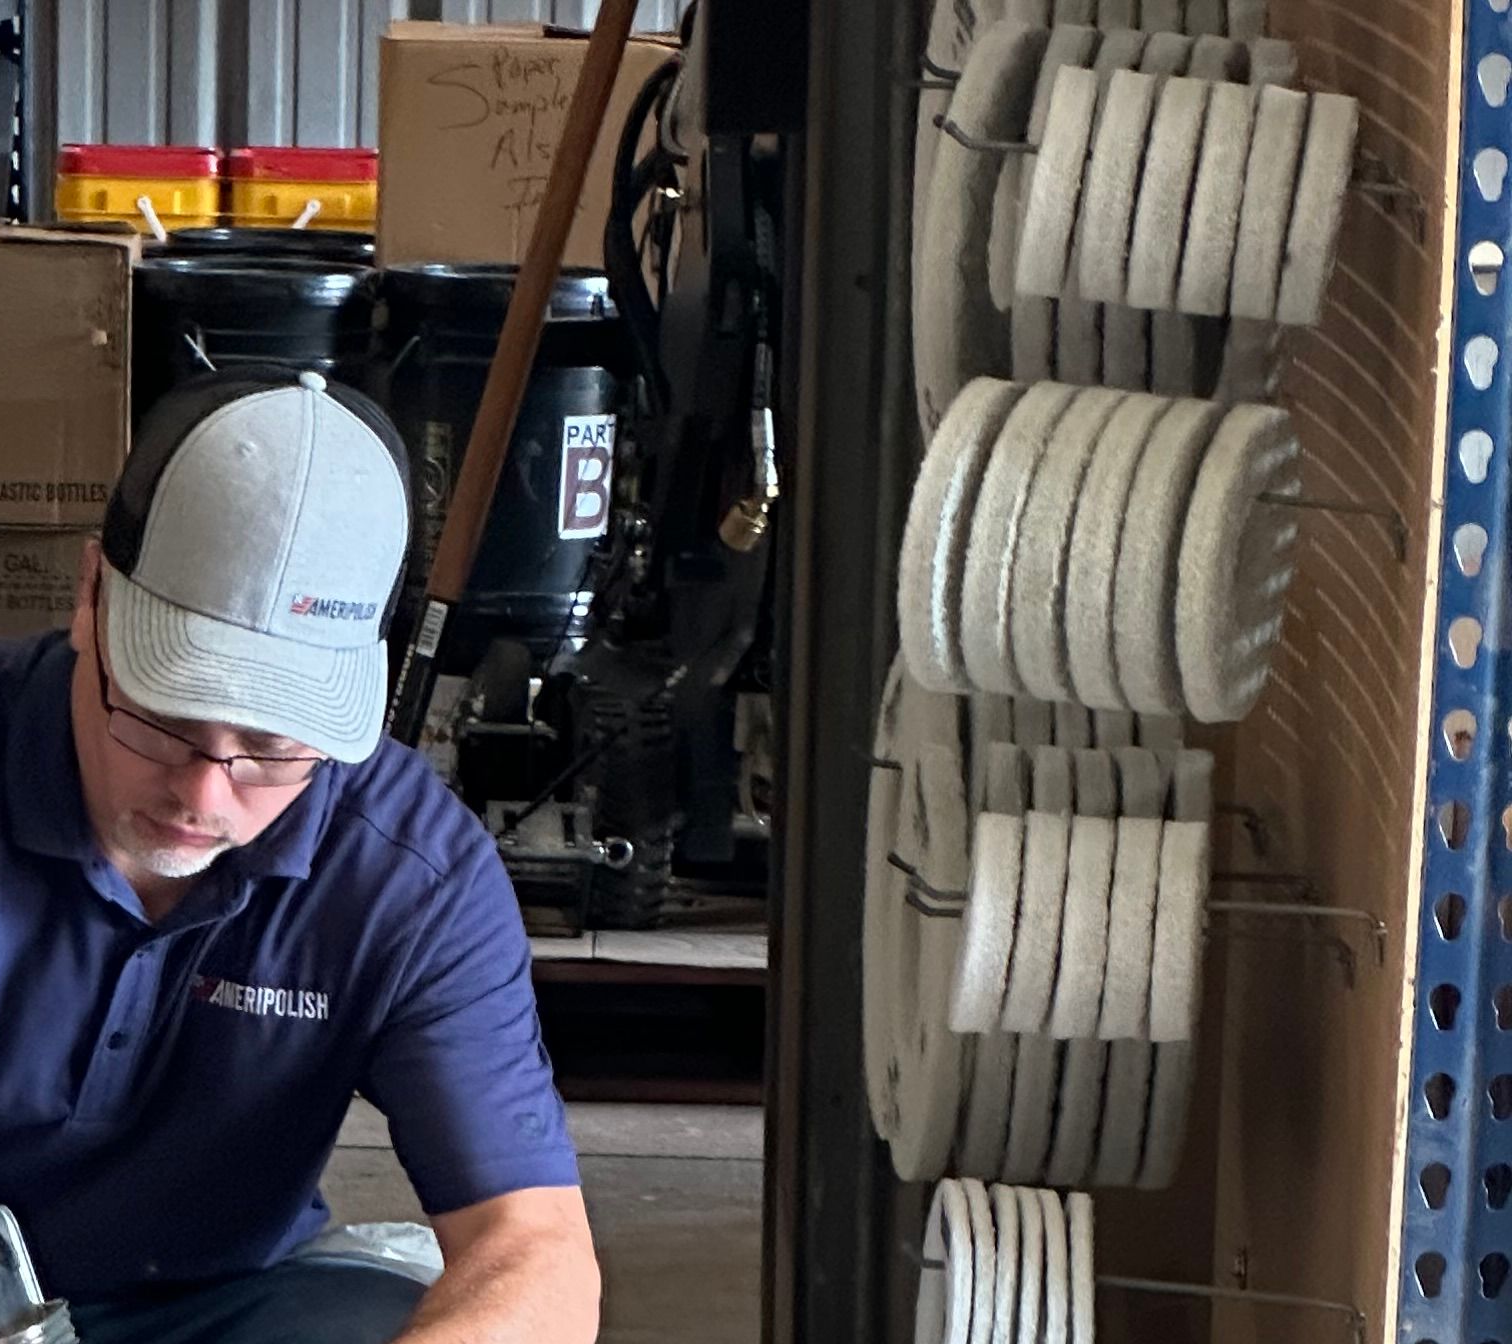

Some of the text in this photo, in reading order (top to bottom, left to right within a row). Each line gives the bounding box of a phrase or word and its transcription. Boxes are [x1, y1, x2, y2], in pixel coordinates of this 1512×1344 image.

[45, 482, 108, 503] BOTTLES
[562, 447, 610, 531] B
[208, 978, 330, 1021] AMERIPOLISH
